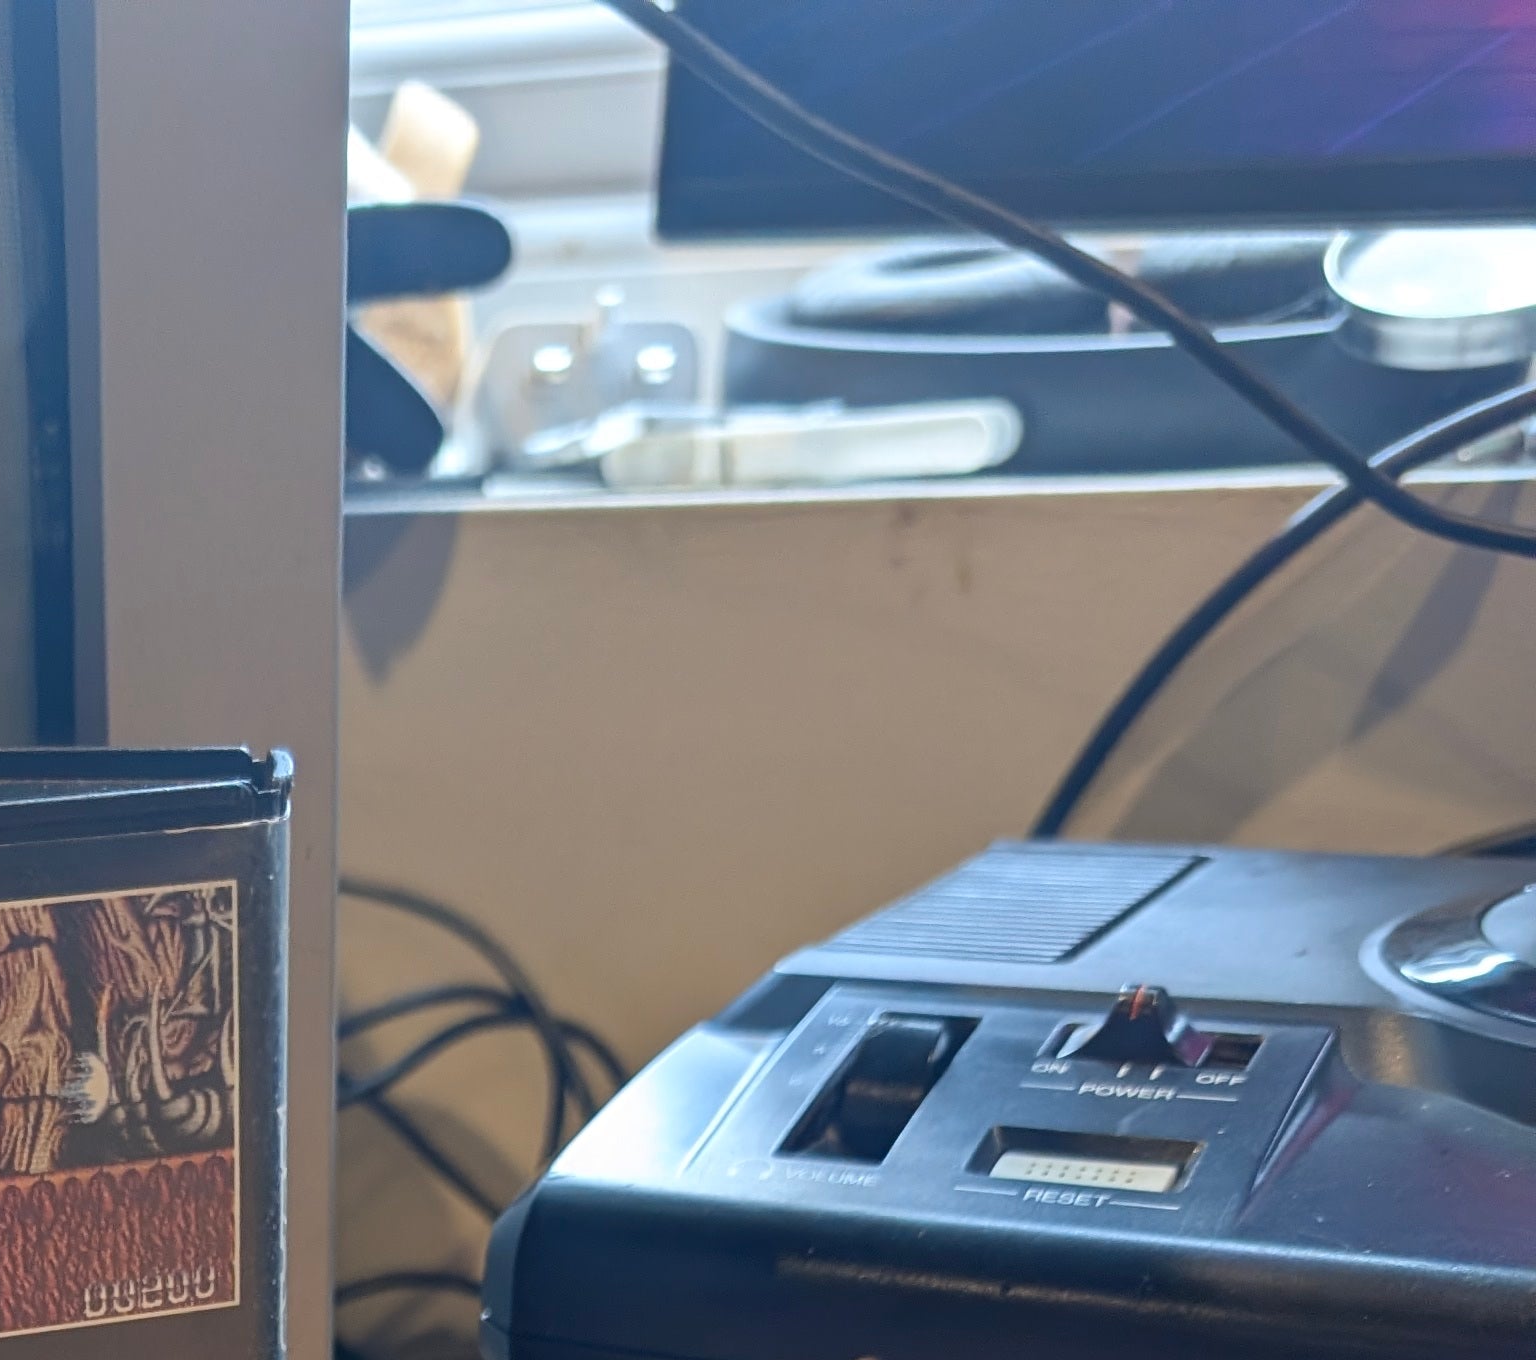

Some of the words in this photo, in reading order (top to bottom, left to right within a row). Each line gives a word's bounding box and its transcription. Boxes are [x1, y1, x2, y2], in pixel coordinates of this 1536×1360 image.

[1030, 1062, 1070, 1075] ON
[1196, 1073, 1247, 1088] OFF
[1078, 1084, 1177, 1101] POWER
[1021, 1189, 1112, 1209] RESET
